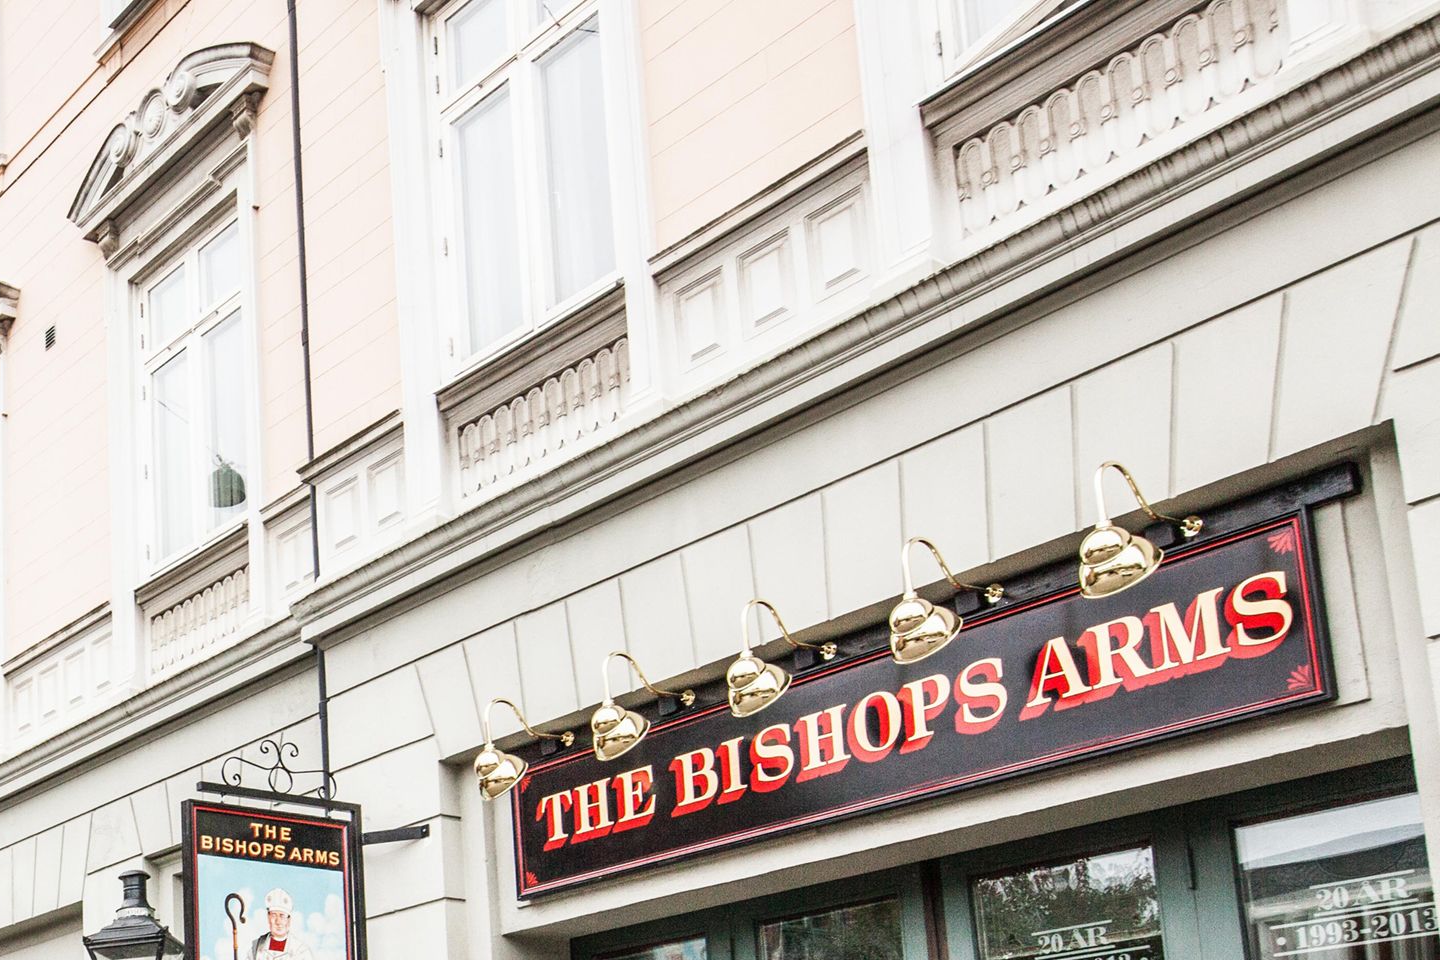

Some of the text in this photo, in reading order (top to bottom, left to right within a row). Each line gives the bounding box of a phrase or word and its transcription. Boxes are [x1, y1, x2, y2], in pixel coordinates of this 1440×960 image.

[536, 570, 1294, 852] THE BISHOPS ARMS
[249, 822, 292, 842] THE
[199, 835, 341, 867] BISHOPS ARMS
[1316, 877, 1411, 911] 20 ÅR
[1038, 926, 1110, 955] 20 ÅR
[1296, 907, 1438, 950] 1993-2013
